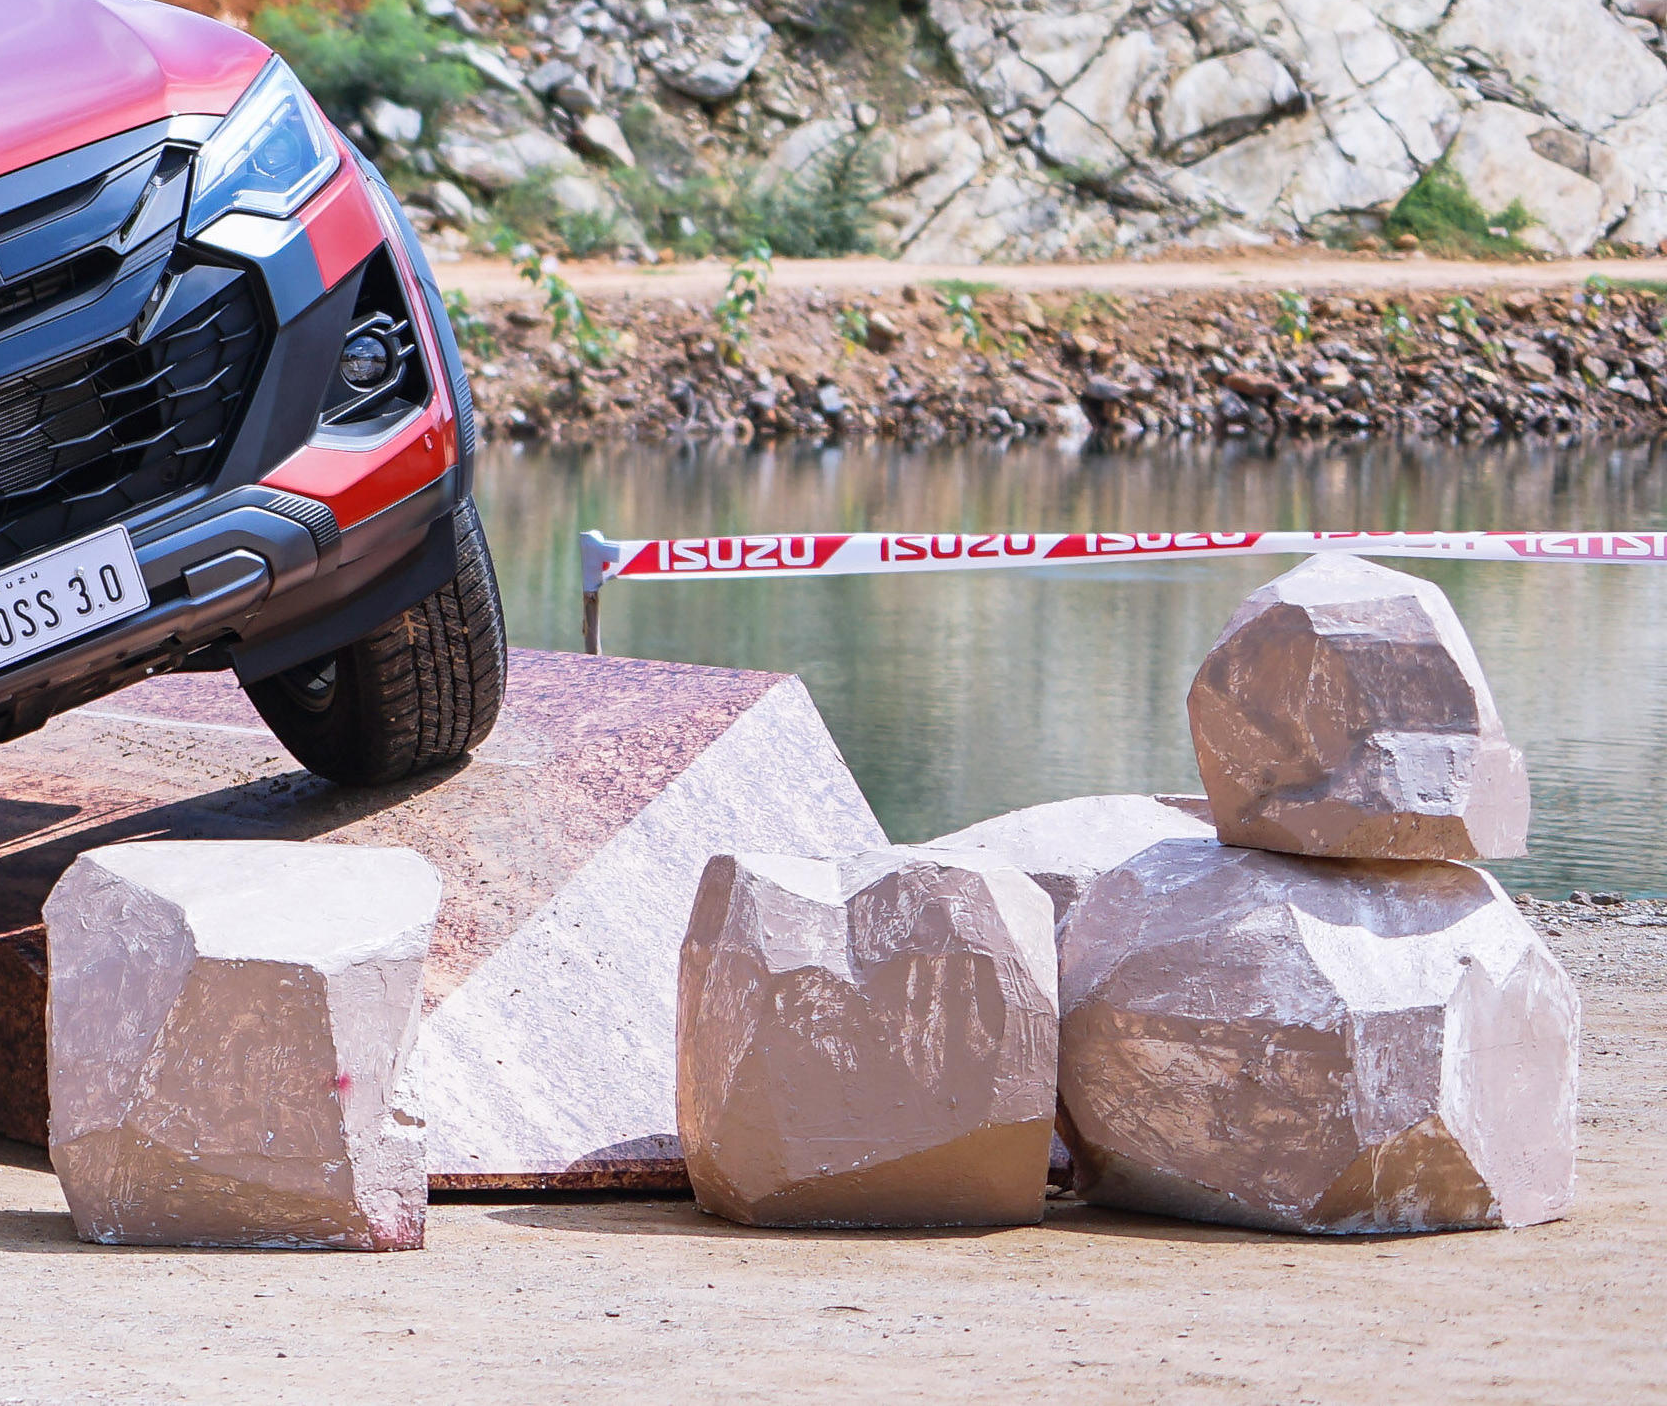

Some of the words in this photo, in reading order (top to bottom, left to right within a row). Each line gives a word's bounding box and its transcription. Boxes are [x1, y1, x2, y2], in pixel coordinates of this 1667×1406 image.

[659, 536, 816, 571] ISUZU
[881, 534, 1036, 562] ISUZU
[68, 564, 124, 616] 3.0
